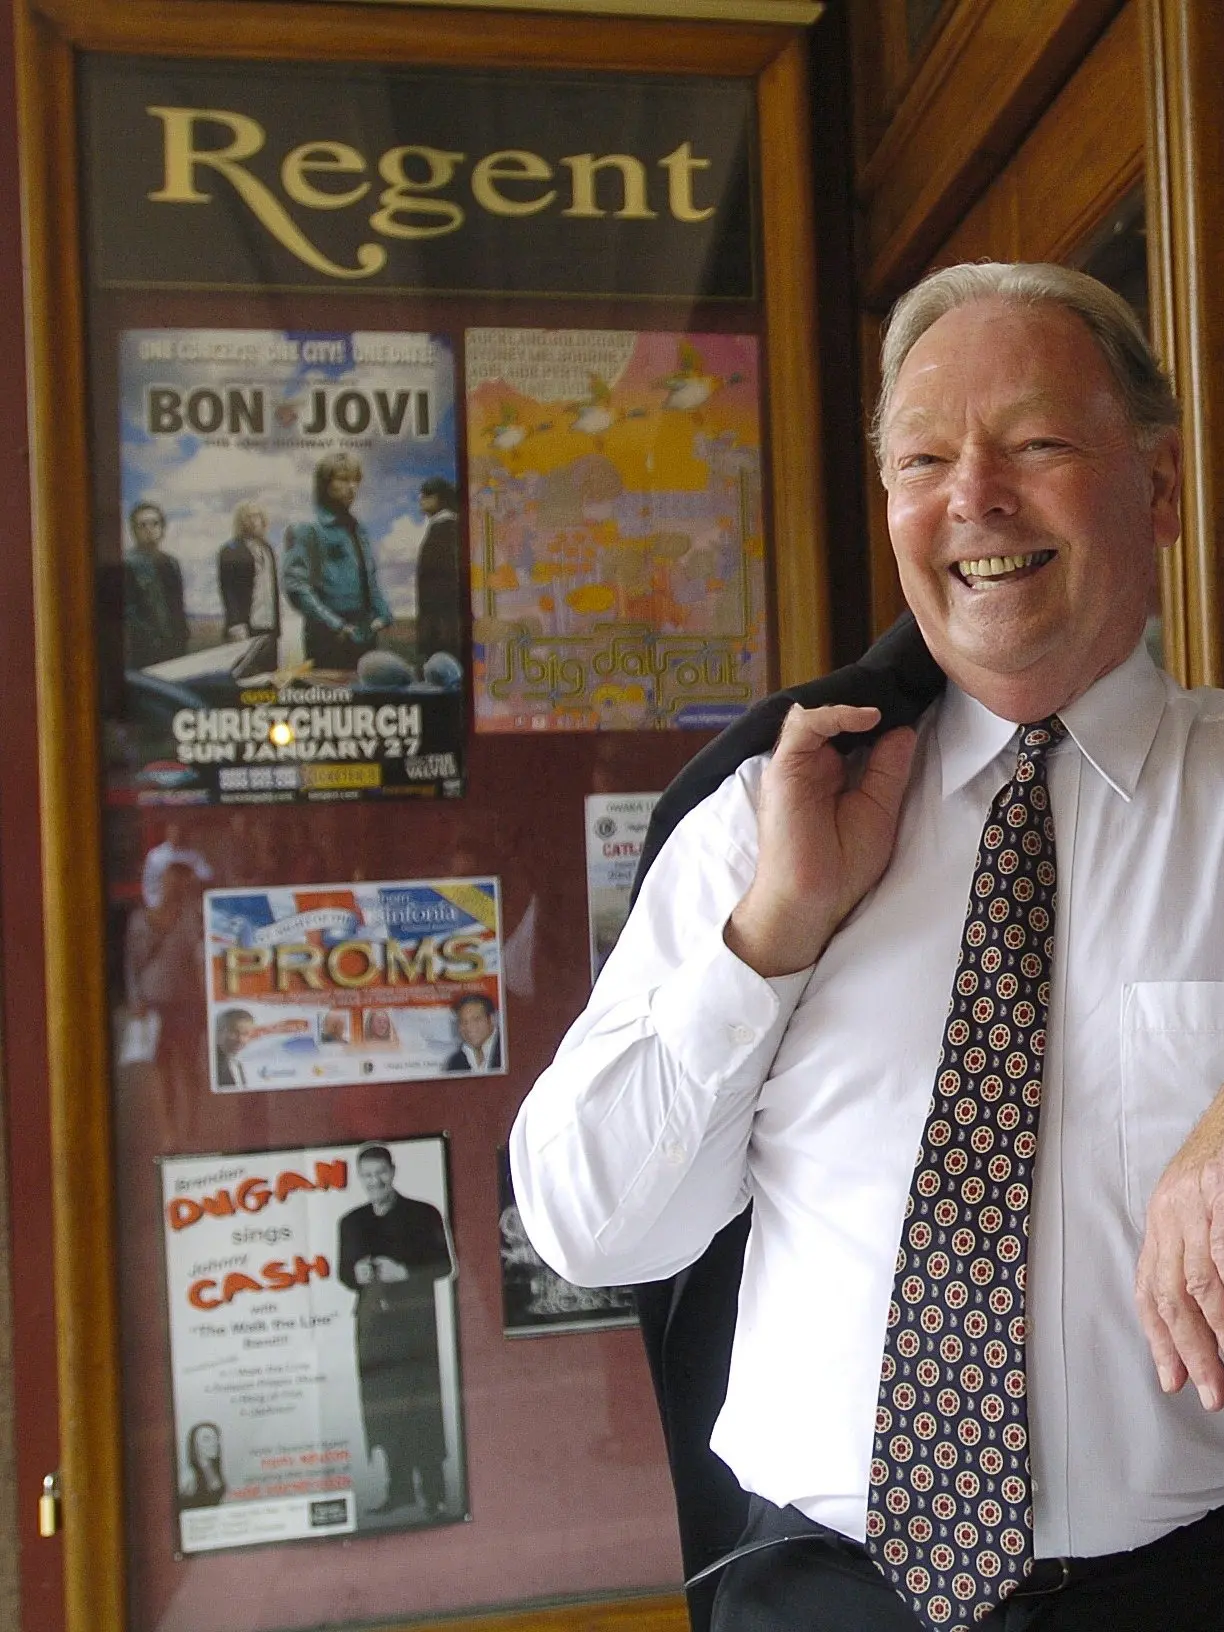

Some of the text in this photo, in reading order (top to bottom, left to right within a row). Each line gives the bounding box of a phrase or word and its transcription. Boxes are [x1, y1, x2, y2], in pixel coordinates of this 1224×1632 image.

[146, 106, 716, 279] Regent
[148, 388, 430, 436] BON JOVI
[277, 685, 353, 704] stadium
[173, 704, 423, 743] CHRISTCHURCH
[177, 737, 420, 763] SUN JANUARY 27
[224, 934, 487, 995] PROMS
[168, 1159, 348, 1231] DUGAN
[231, 1224, 293, 1246] sings
[187, 1253, 332, 1311] CASH
